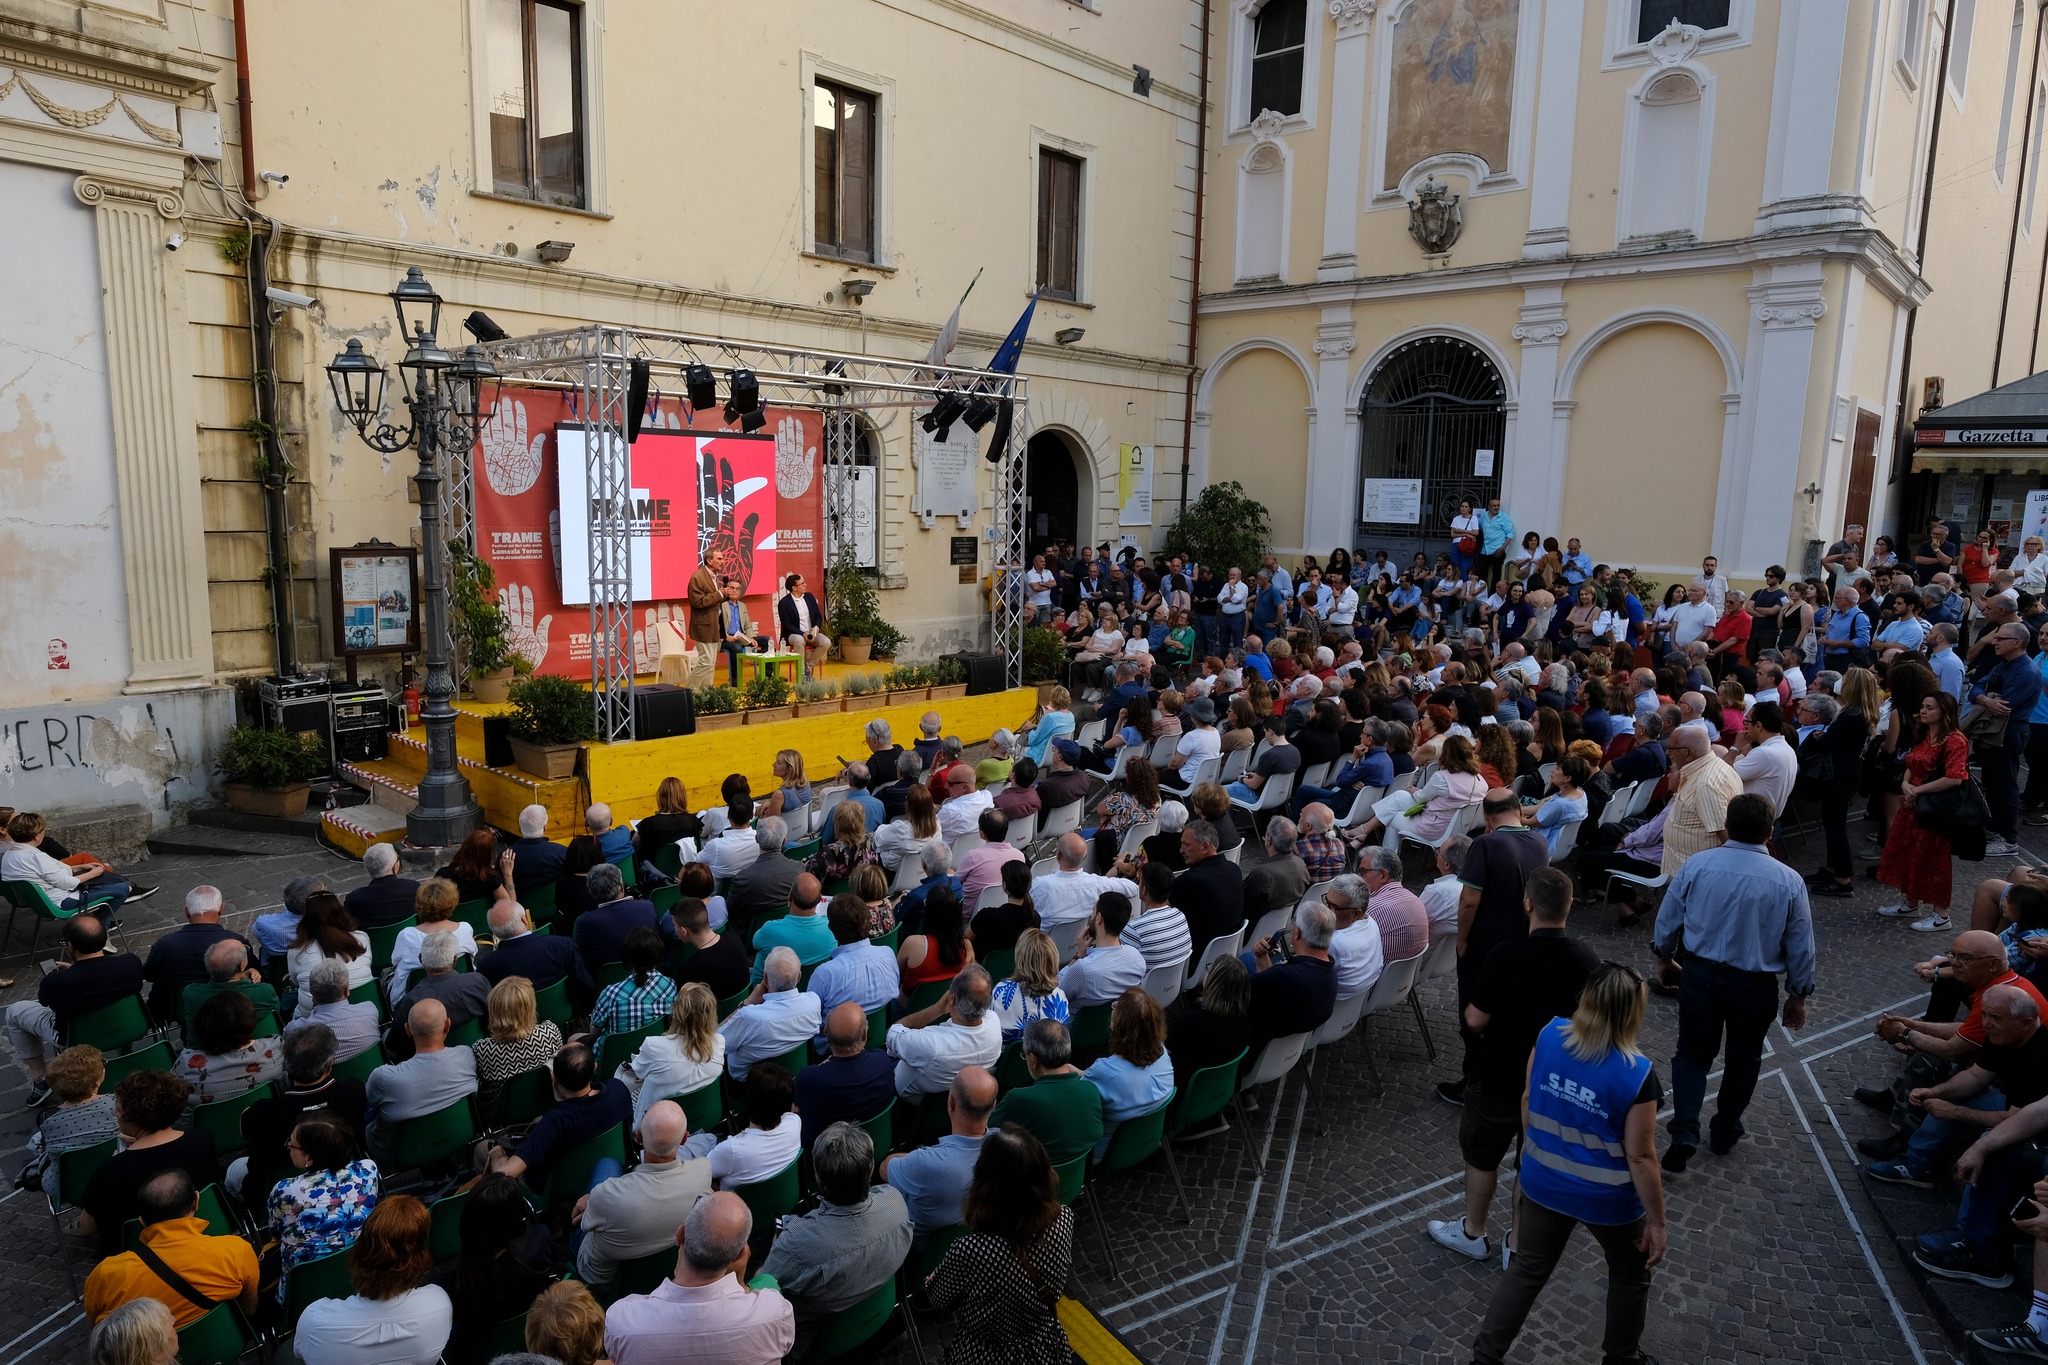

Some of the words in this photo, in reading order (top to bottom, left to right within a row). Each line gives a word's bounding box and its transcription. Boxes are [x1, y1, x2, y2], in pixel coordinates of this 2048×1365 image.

[1959, 430, 2033, 442] Gazzetta
[492, 532, 542, 543] TRAME
[776, 530, 813, 539] TRAME
[1548, 1072, 1601, 1108] S.E.R.
[1591, 1107, 1608, 1119] RADIO
